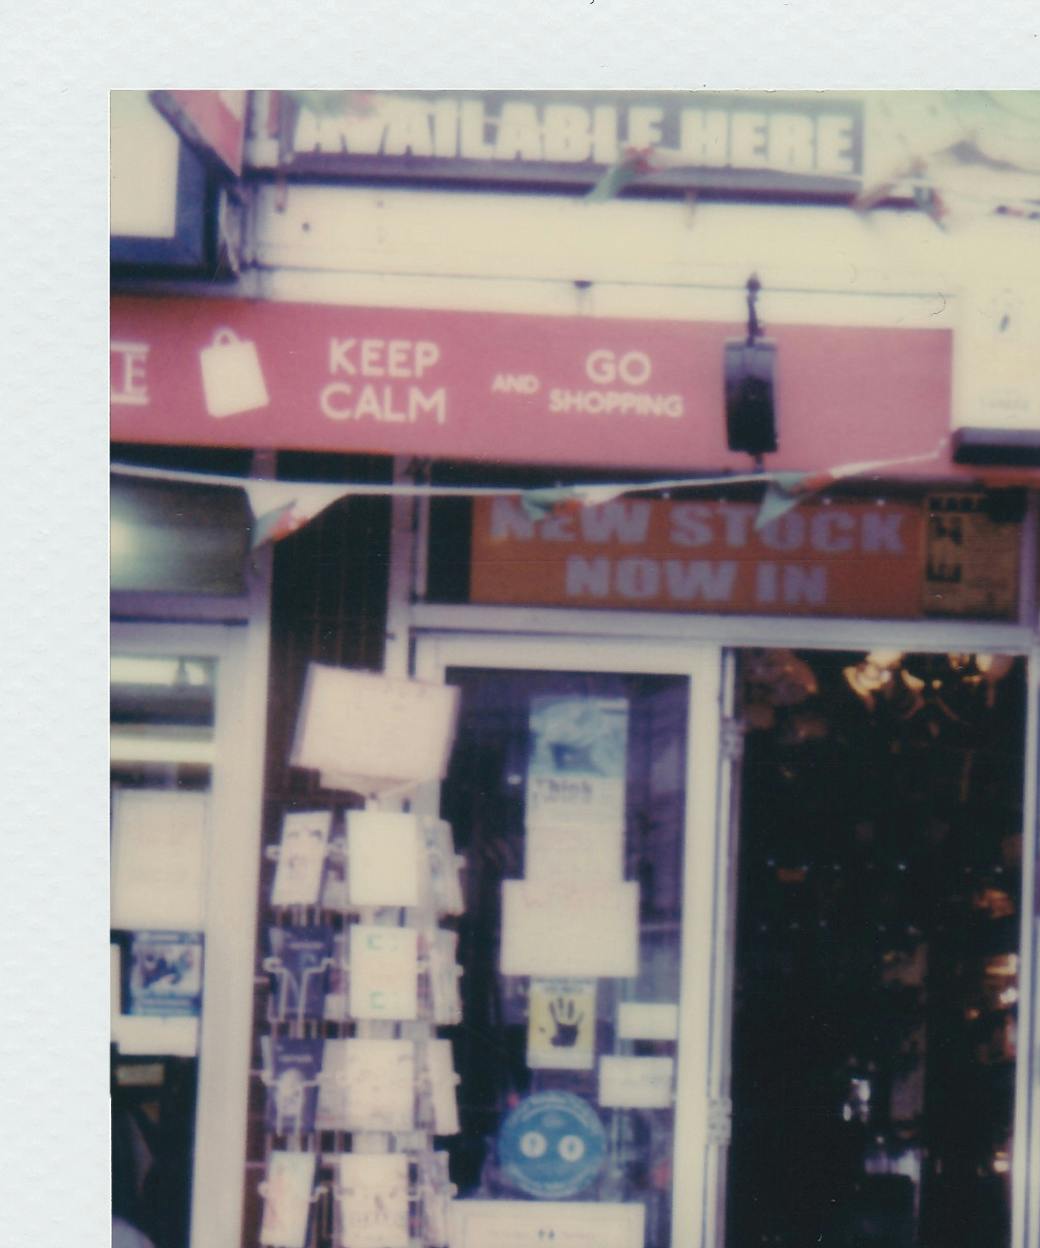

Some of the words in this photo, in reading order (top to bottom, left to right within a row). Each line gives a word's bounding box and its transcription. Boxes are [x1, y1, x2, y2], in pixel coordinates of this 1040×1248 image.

[293, 99, 664, 164] AVAILABLE
[680, 106, 855, 175] HERE
[329, 337, 441, 378] KEEP
[584, 349, 652, 387] GO
[319, 382, 447, 424] CALM
[490, 373, 541, 396] AND
[547, 388, 685, 419] SHOPPING
[666, 502, 907, 555] STOCK
[564, 553, 740, 603] NOW
[753, 560, 829, 606] IN
